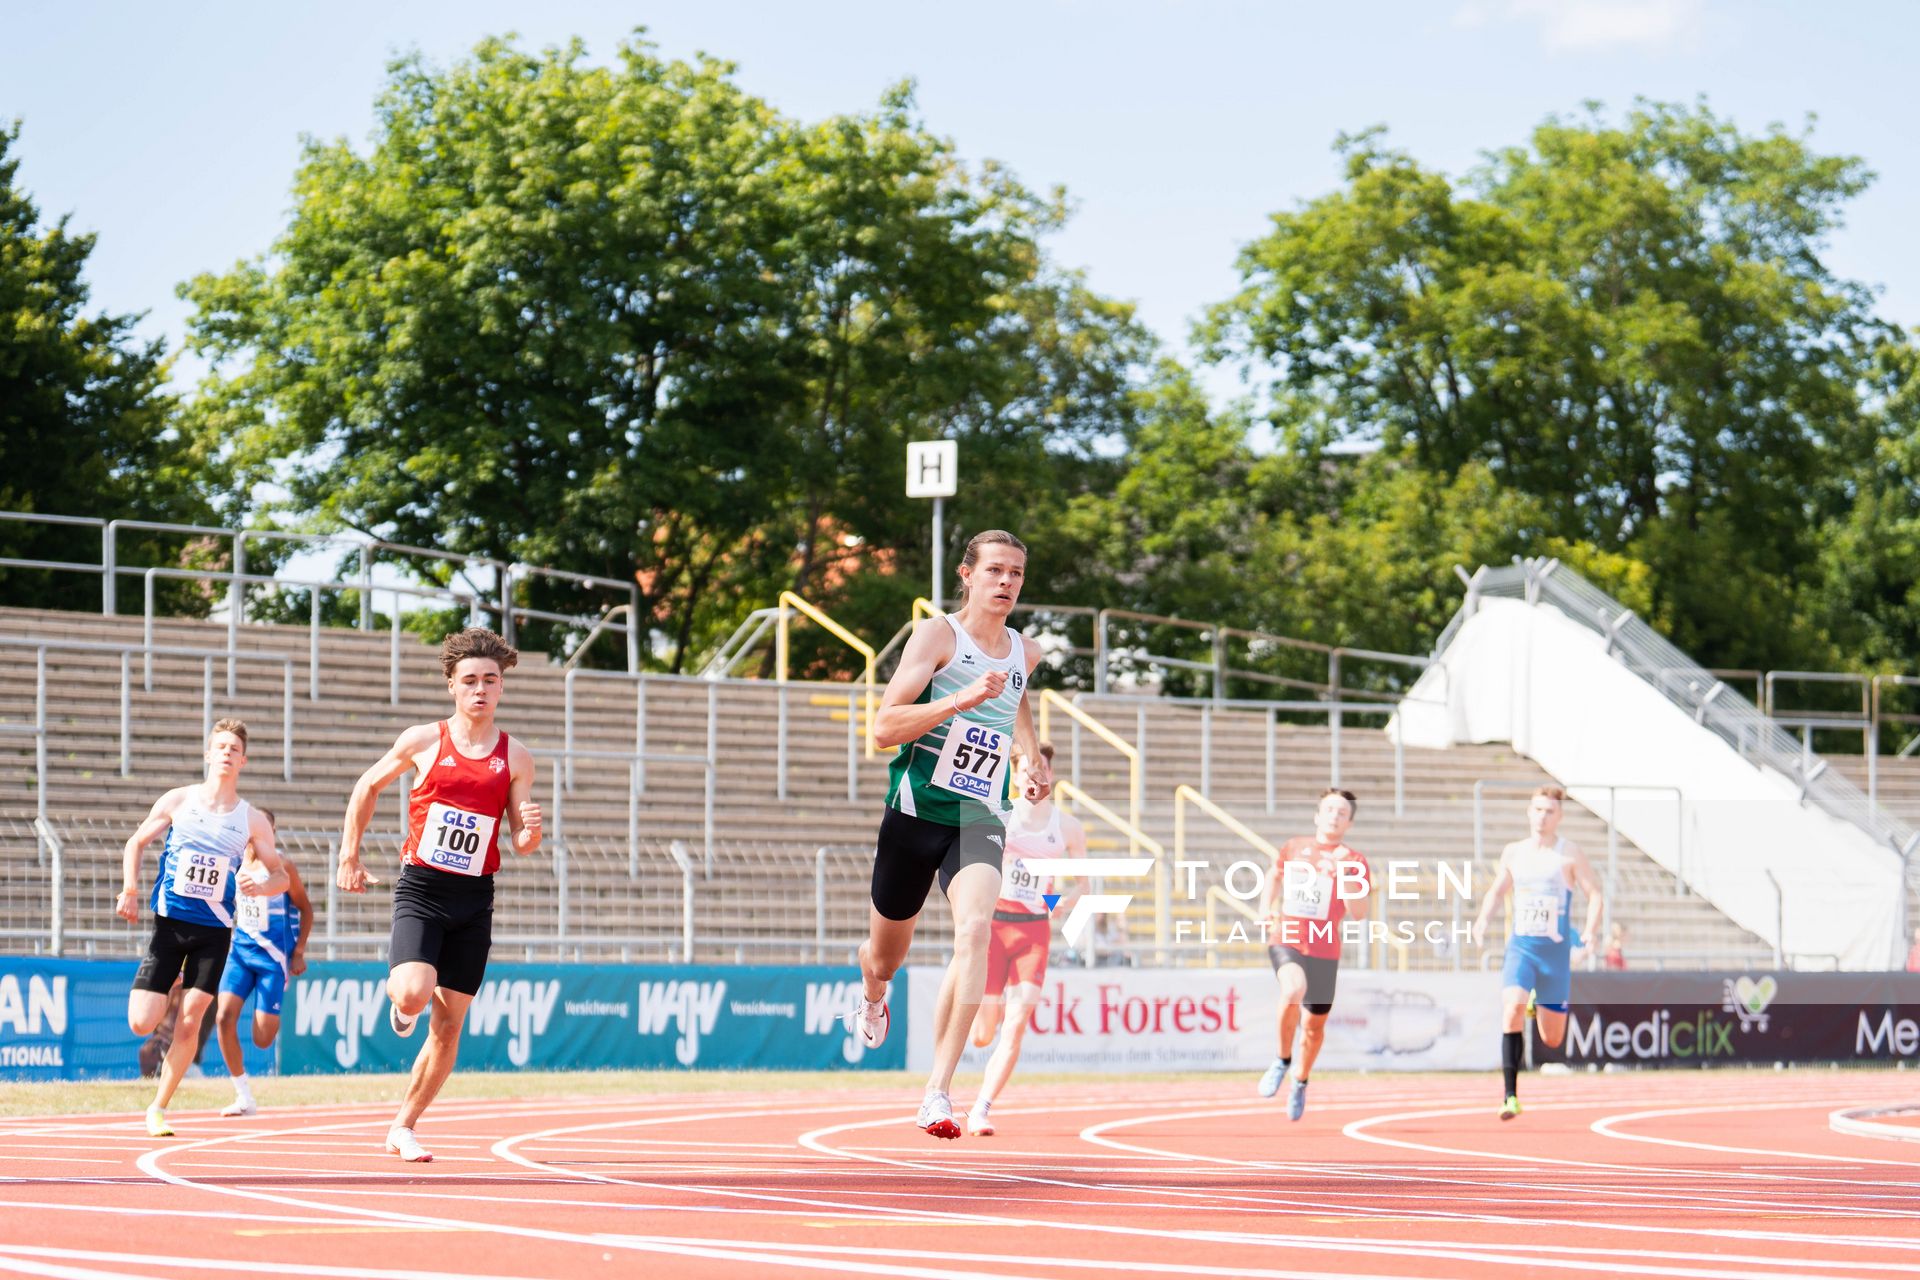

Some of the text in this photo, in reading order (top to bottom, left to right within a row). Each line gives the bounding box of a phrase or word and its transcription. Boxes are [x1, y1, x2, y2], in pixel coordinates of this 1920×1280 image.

[920, 452, 942, 485] H
[953, 743, 1001, 778] 577
[437, 825, 480, 855] 100
[186, 866, 220, 886] 418
[191, 855, 216, 867] GLS
[1011, 870, 1040, 889] 991
[564, 1000, 629, 1018] Versicherung
[731, 1000, 796, 1019] Versicherung
[1098, 984, 1241, 1034] Forest
[1566, 1010, 1735, 1059] Mediclix
[1856, 1009, 1920, 1056] Me
